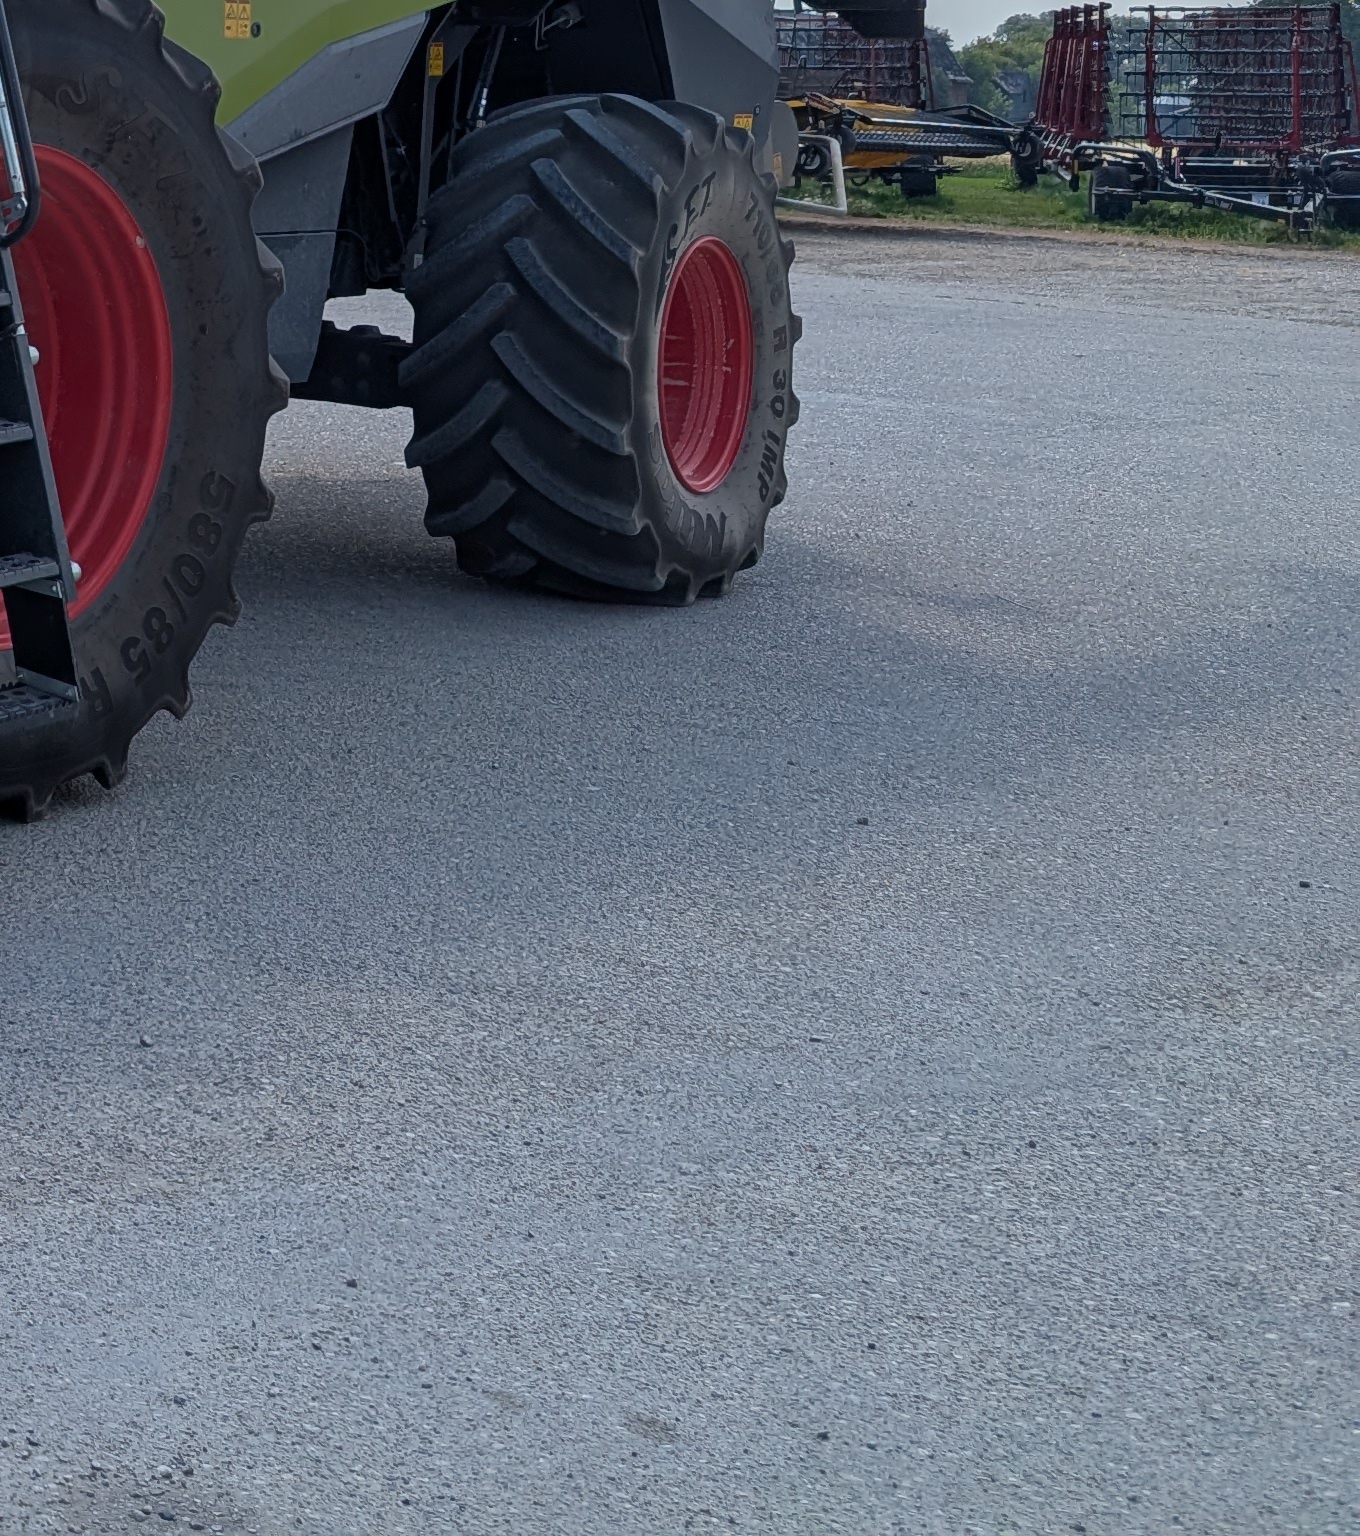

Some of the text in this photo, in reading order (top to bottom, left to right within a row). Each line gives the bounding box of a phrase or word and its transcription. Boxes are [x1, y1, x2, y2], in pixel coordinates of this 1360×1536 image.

[773, 324, 788, 354] R
[770, 368, 787, 420] 30
[757, 429, 781, 503] IMP
[118, 468, 237, 687] 580/85
